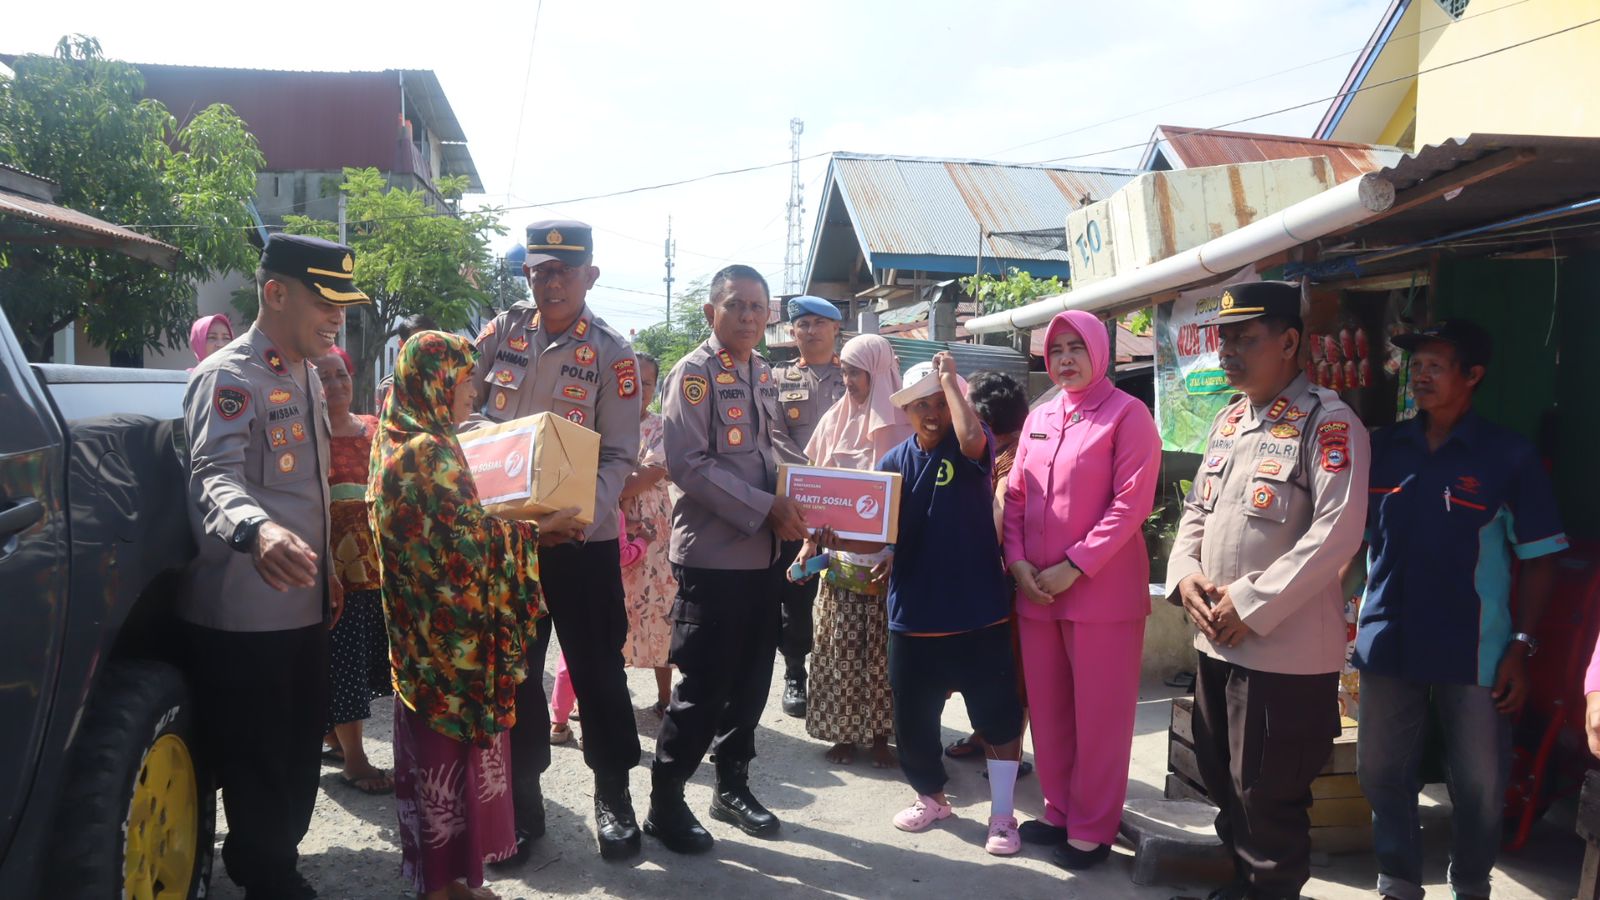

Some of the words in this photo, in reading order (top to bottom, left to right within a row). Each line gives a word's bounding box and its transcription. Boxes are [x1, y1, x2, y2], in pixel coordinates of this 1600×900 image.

[496, 351, 528, 368] AHMAD
[560, 364, 599, 384] POLRI
[718, 389, 745, 399] YOSEPH
[269, 404, 300, 421] MISBAH
[1260, 442, 1298, 457] POLRI
[477, 460, 503, 473] SOSIAL
[822, 496, 853, 507] SOSIAL
